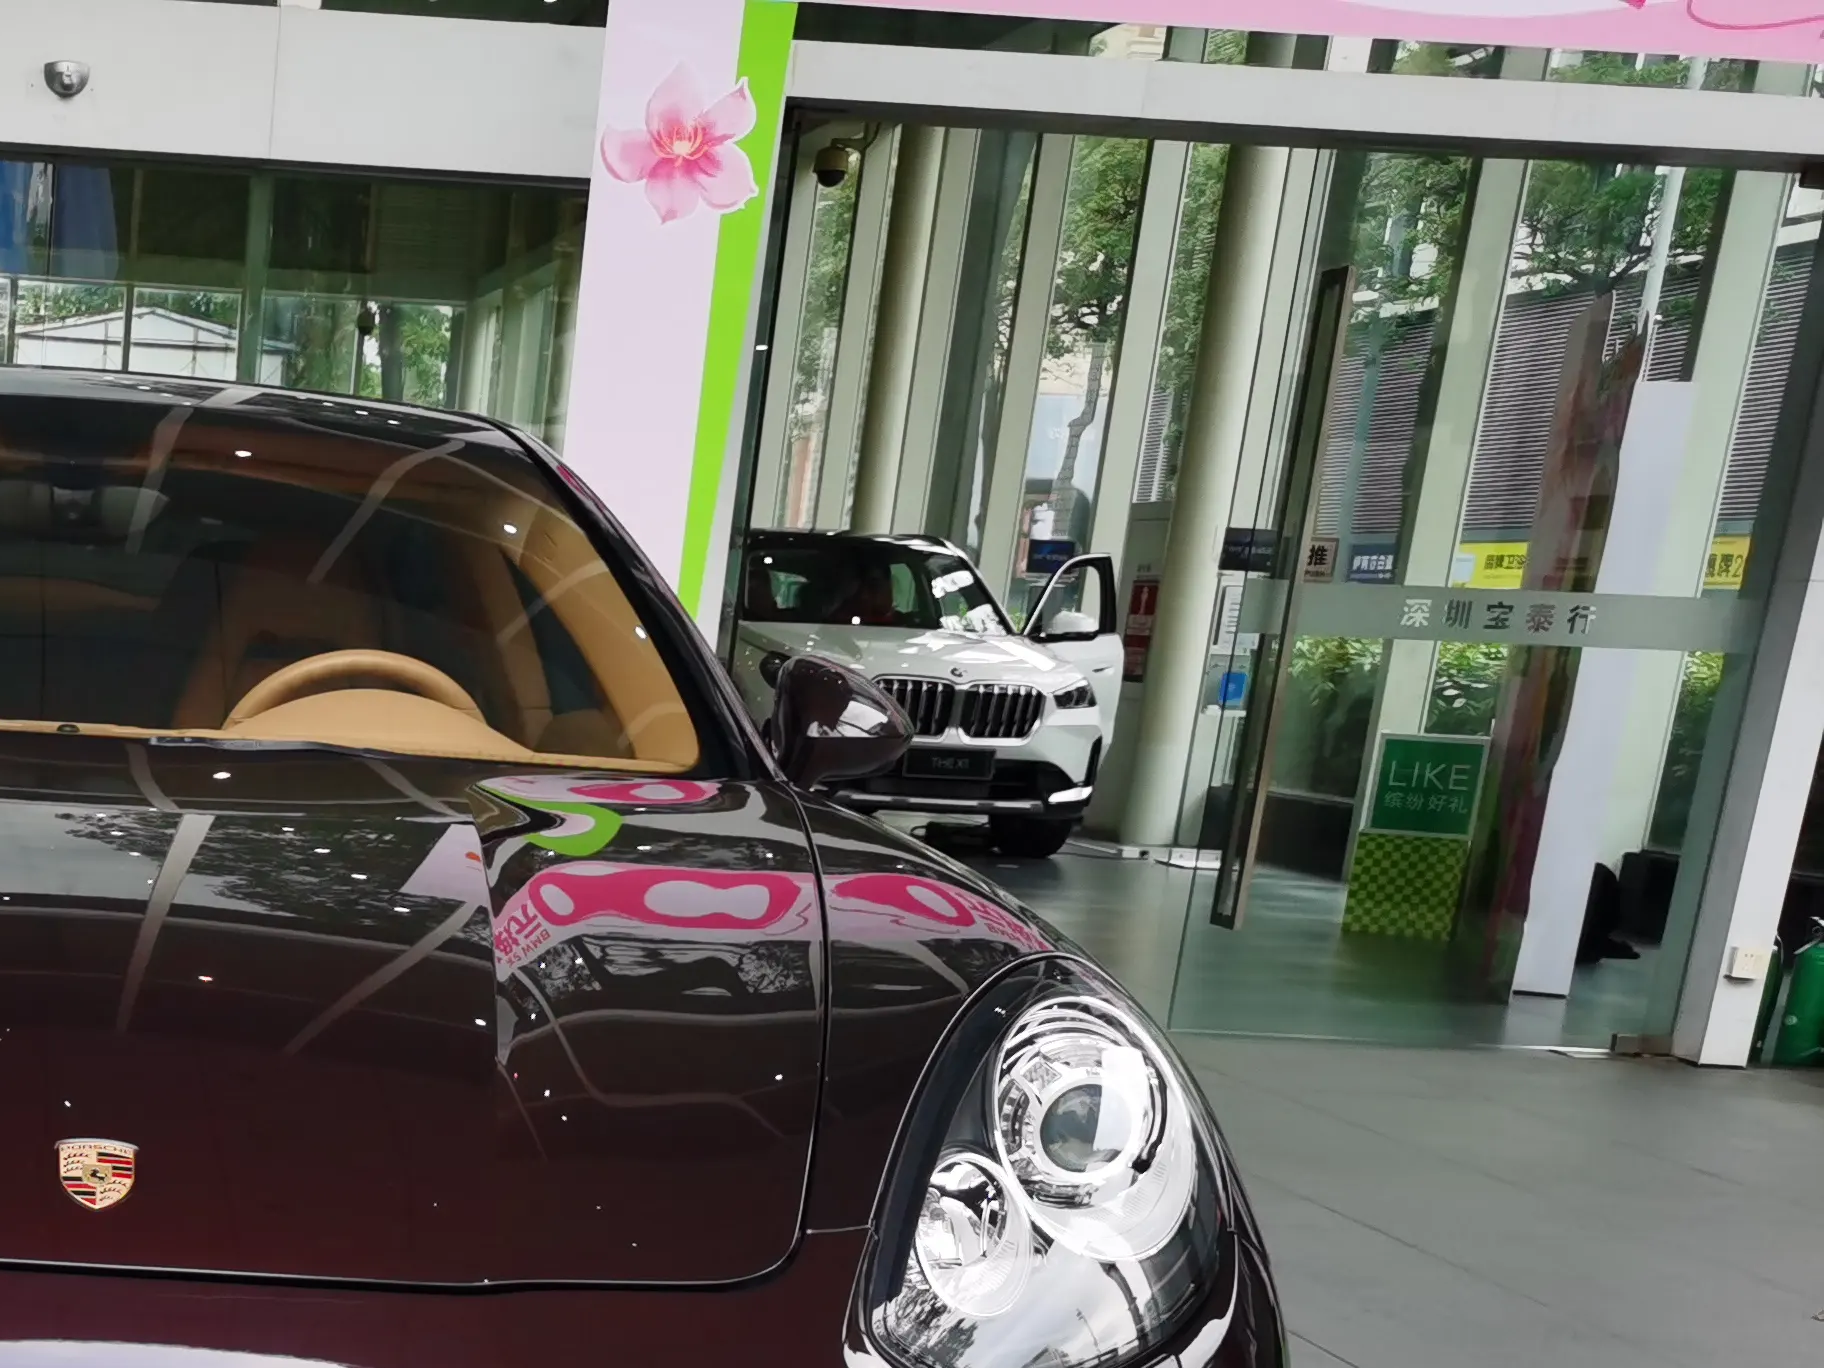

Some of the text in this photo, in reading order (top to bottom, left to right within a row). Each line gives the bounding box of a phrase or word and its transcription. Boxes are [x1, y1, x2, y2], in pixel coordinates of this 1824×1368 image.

[1307, 544, 1329, 567] 推
[1400, 598, 1597, 635] 深圳宝泰行
[1388, 760, 1472, 791] LIKE
[1384, 791, 1468, 814] 缤纷好礼
